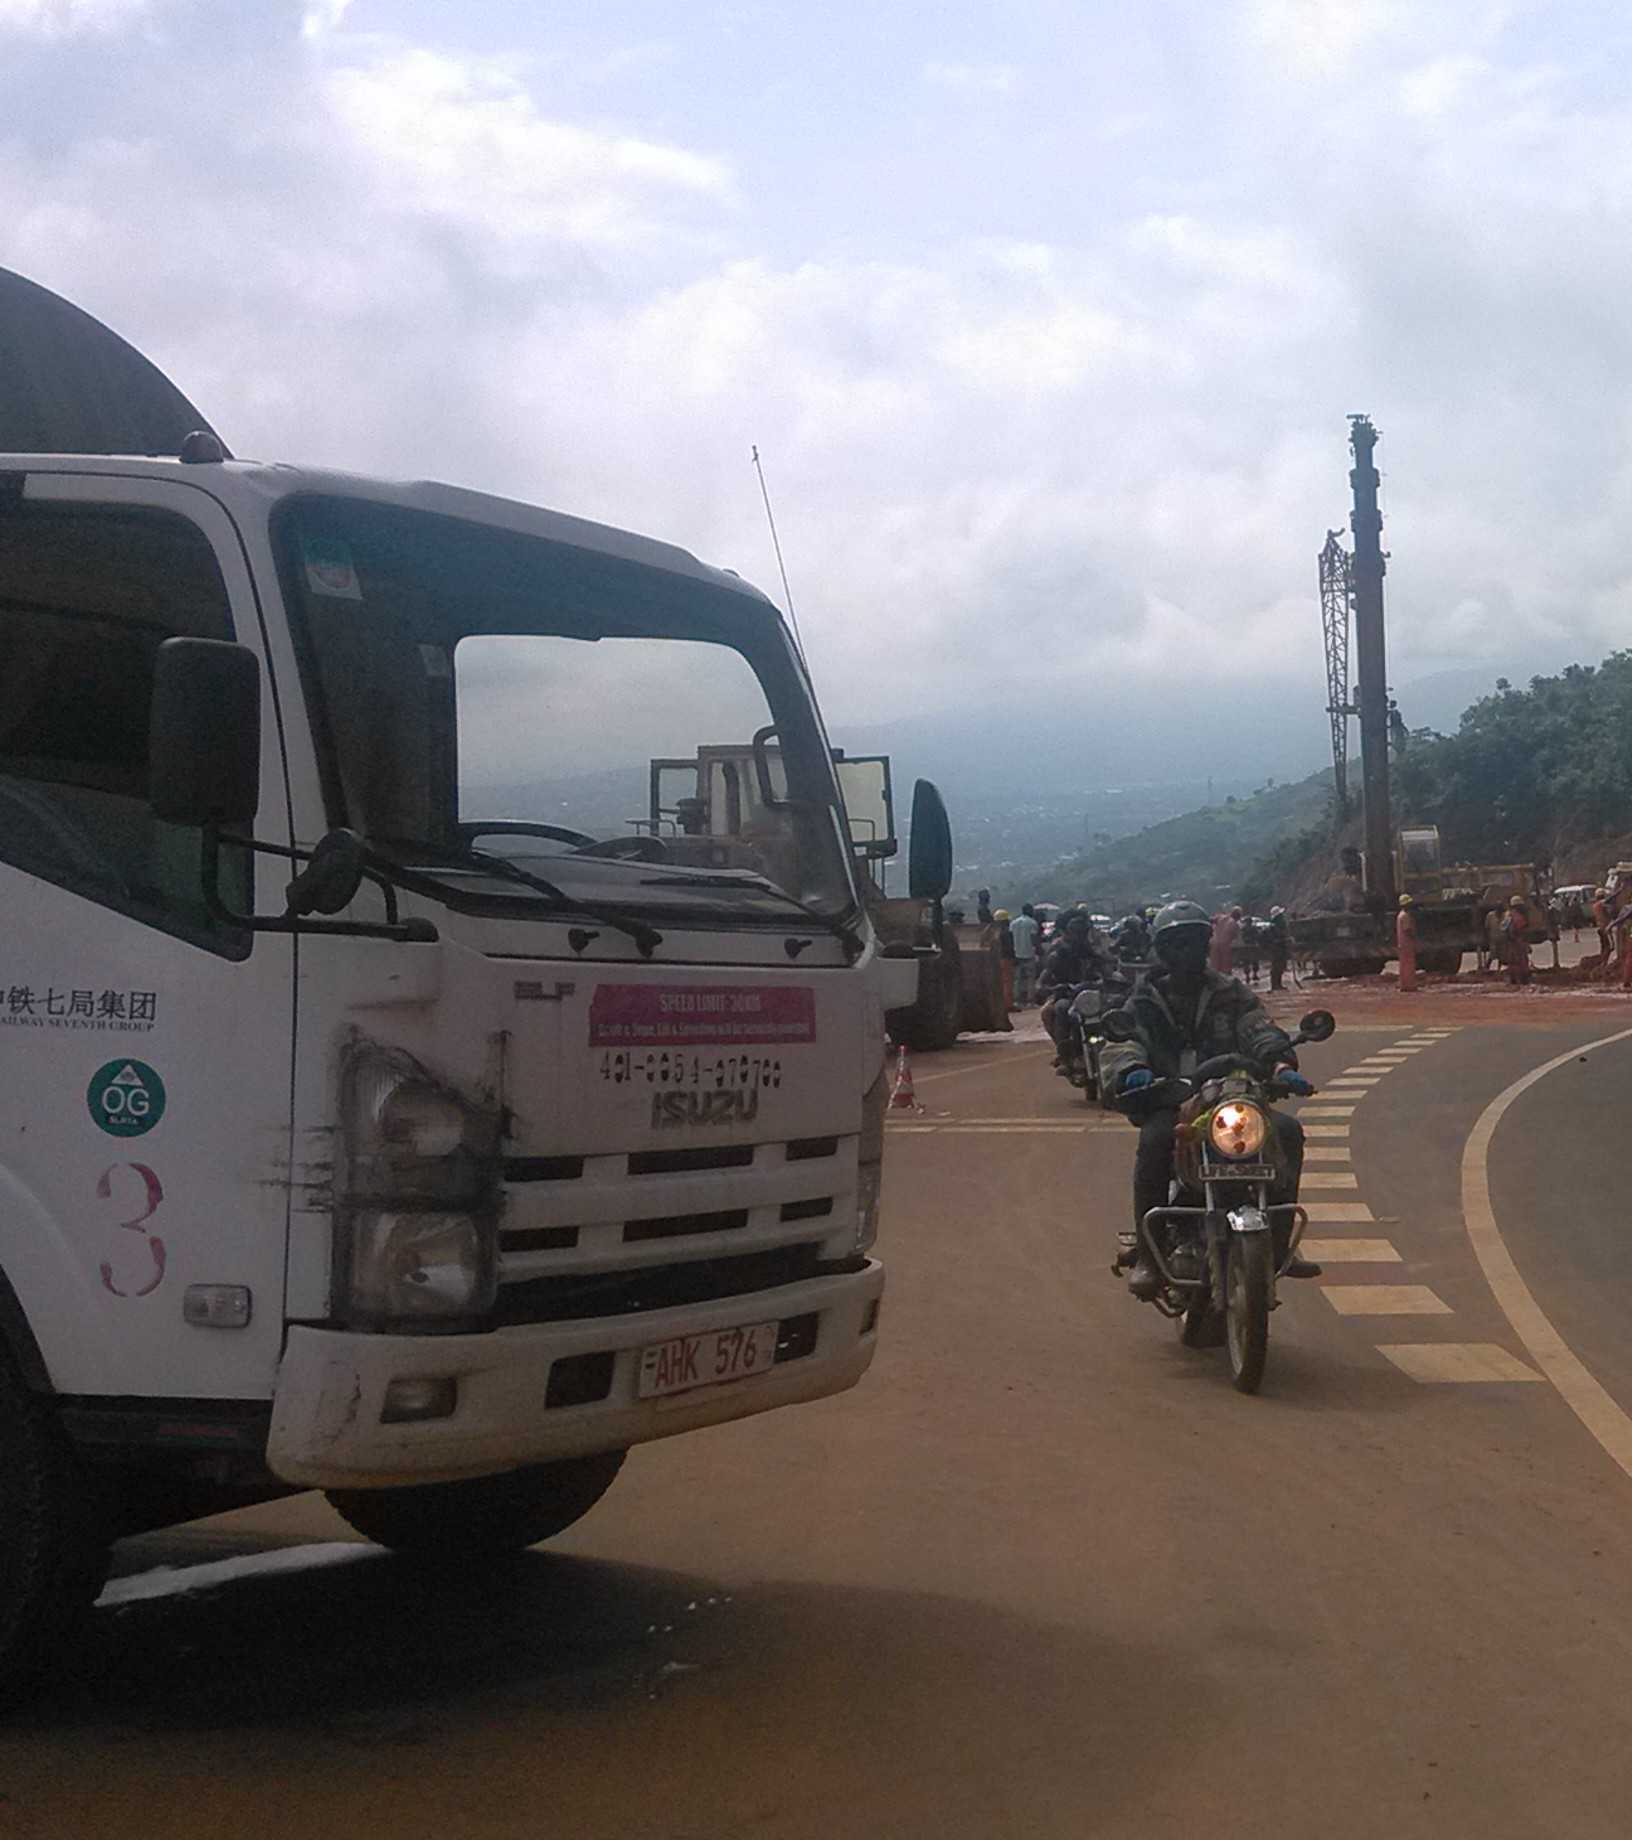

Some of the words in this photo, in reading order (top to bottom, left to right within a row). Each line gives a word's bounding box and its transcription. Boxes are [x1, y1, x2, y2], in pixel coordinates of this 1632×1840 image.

[0, 985, 156, 1021] 铁七局集团
[48, 1018, 106, 1031] SEVENTH
[109, 1021, 155, 1033] GROUP
[102, 1086, 149, 1116] OG
[651, 1089, 758, 1129] ISUZU
[96, 1162, 167, 1298] 3
[655, 1339, 701, 1388] AHK
[715, 1328, 757, 1375] 576
